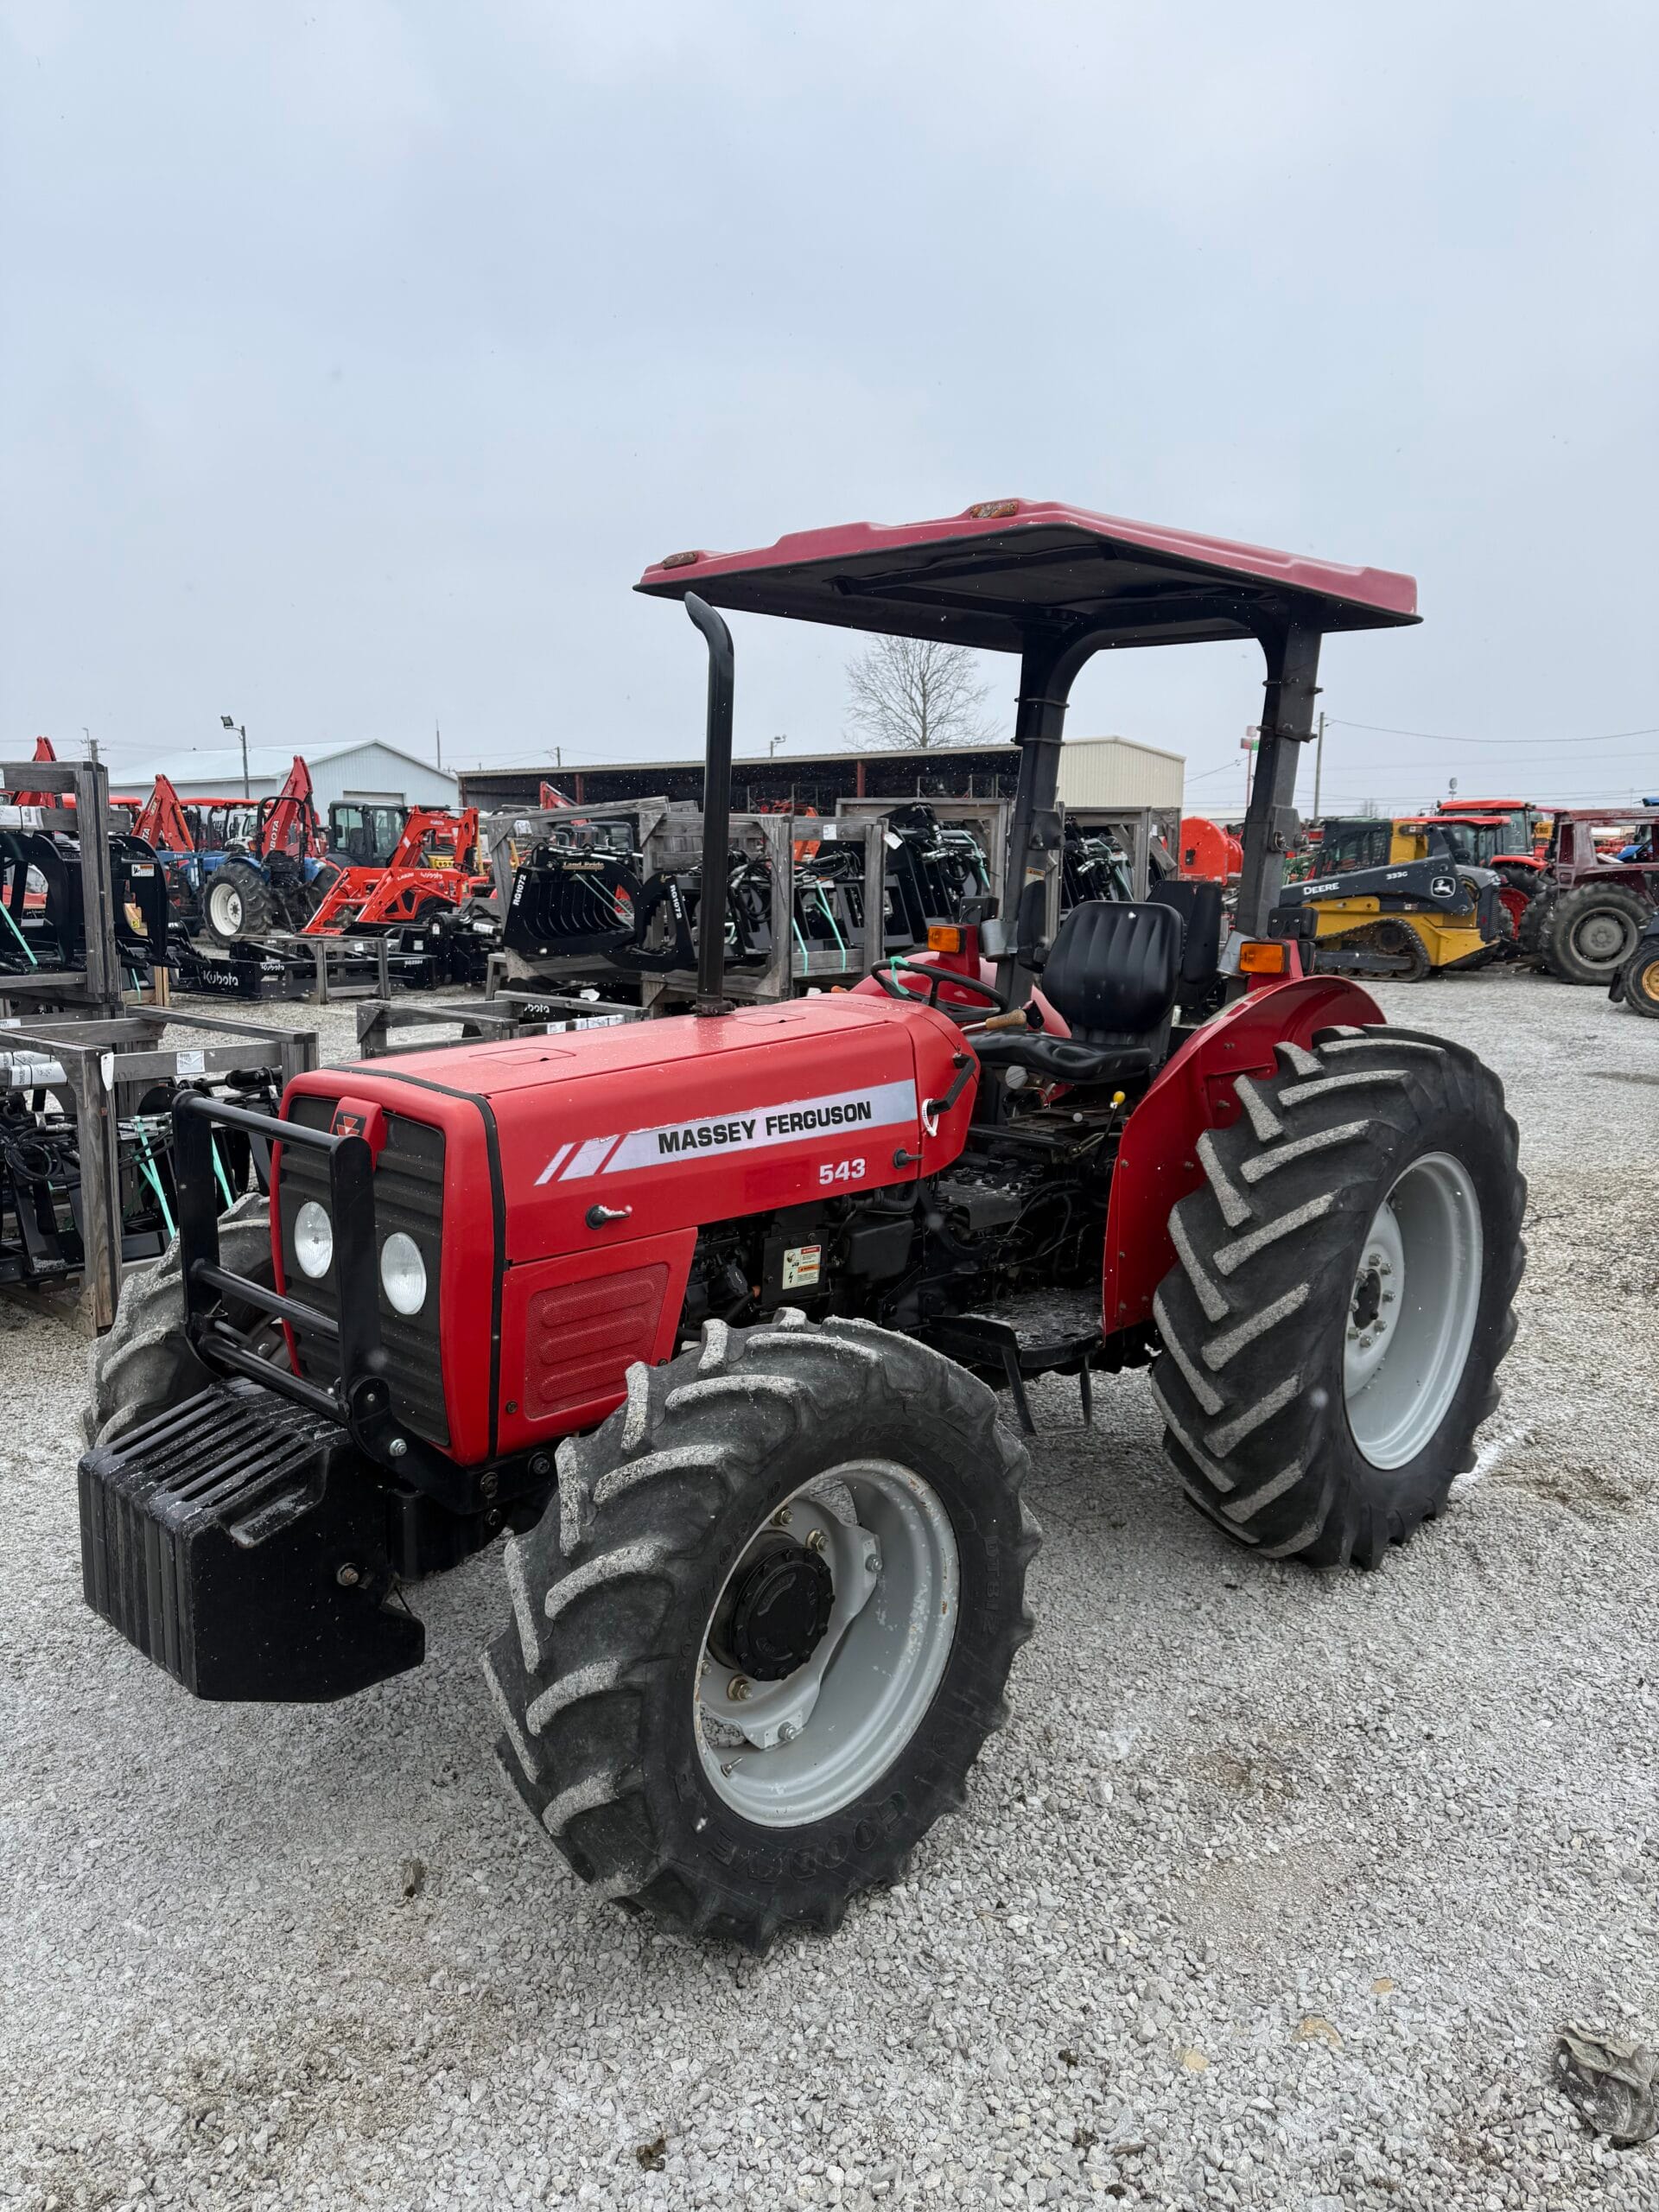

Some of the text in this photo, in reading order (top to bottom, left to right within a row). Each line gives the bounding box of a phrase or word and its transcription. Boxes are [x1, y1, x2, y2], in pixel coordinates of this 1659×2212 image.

[270, 820, 279, 850] BOTA
[1303, 882, 1339, 895] DEERE
[202, 970, 238, 986] Kubota
[524, 1003, 550, 1013] bota
[658, 1101, 871, 1154] MASSEY FERGUSON
[818, 1158, 867, 1185] 543
